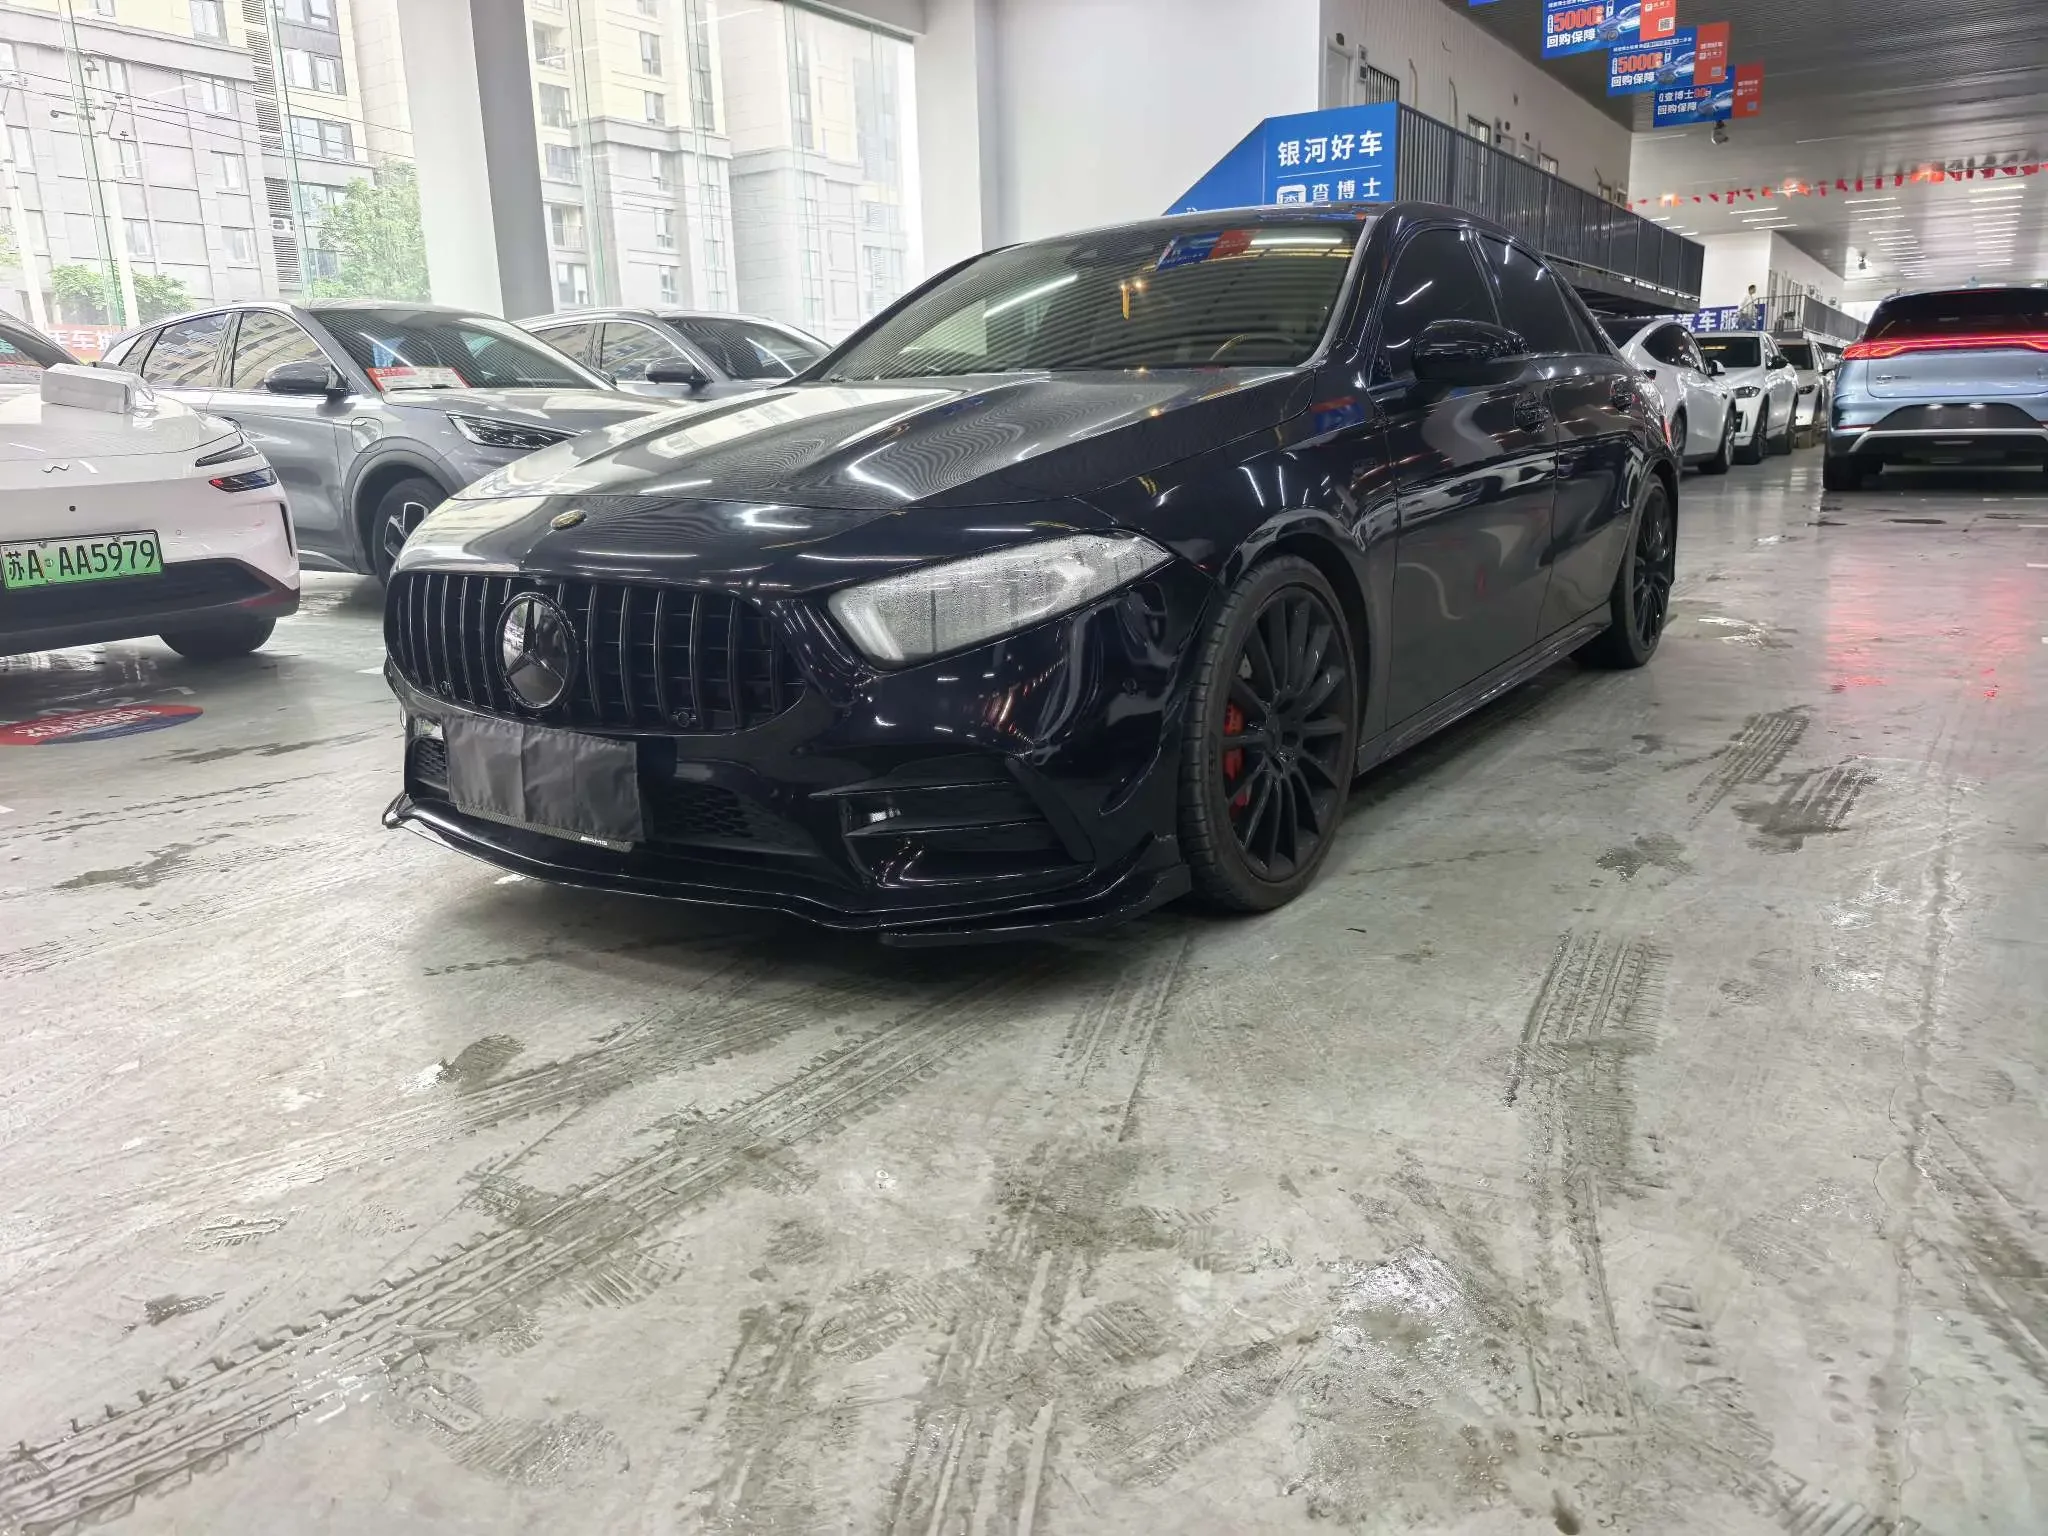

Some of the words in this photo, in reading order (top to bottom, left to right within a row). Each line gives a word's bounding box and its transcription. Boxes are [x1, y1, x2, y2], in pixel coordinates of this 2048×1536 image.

[1547, 28, 1596, 48] 回购保障
[1611, 71, 1655, 87] 回购保障
[1657, 101, 1697, 115] 回购保障
[1277, 129, 1383, 167] 银河好车
[1311, 177, 1382, 203] 查博士
